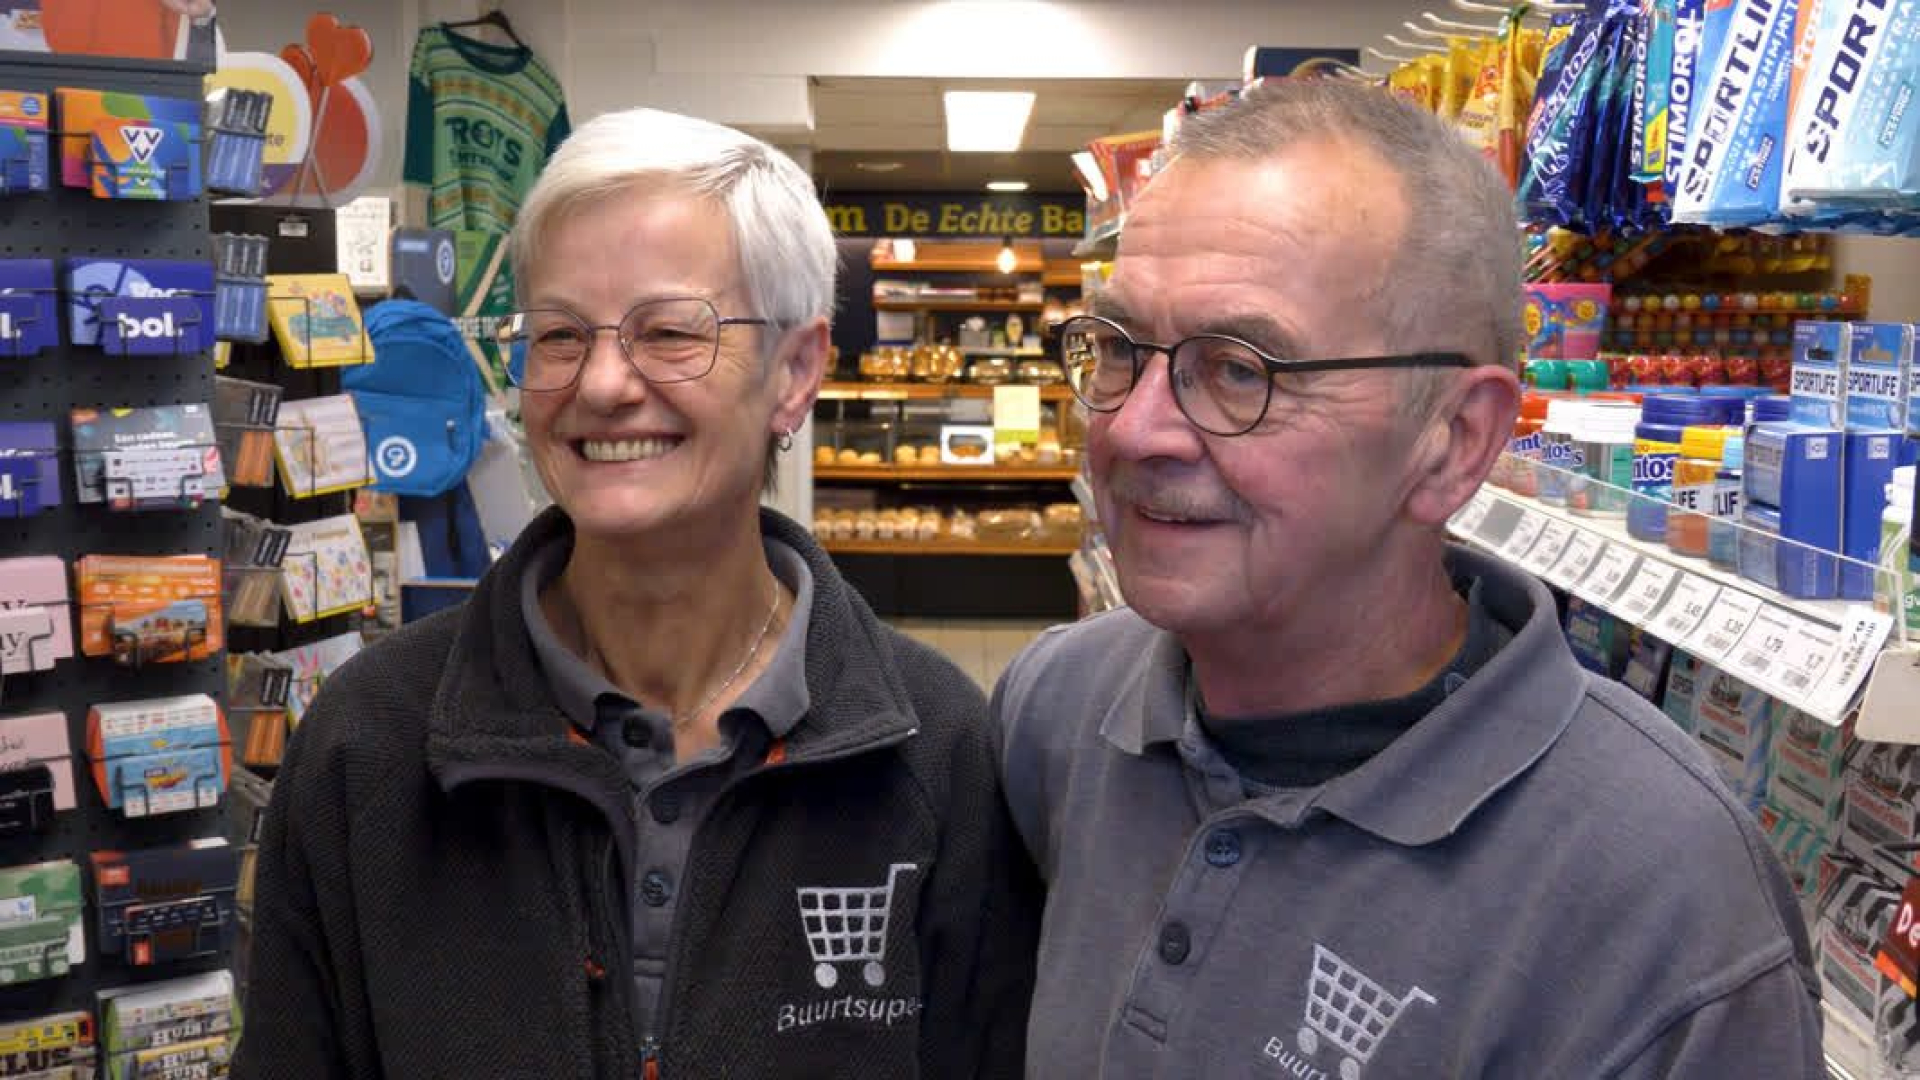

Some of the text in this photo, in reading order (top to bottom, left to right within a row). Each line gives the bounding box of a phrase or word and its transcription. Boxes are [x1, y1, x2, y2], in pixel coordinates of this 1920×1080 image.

[1630, 19, 1650, 167] STIMOROL
[885, 203, 930, 232] De
[937, 203, 1034, 233] Echte
[1041, 205, 1083, 234] Ba
[1793, 370, 1837, 395] SPORTLIFE
[1847, 370, 1898, 397] SPORTLIFE
